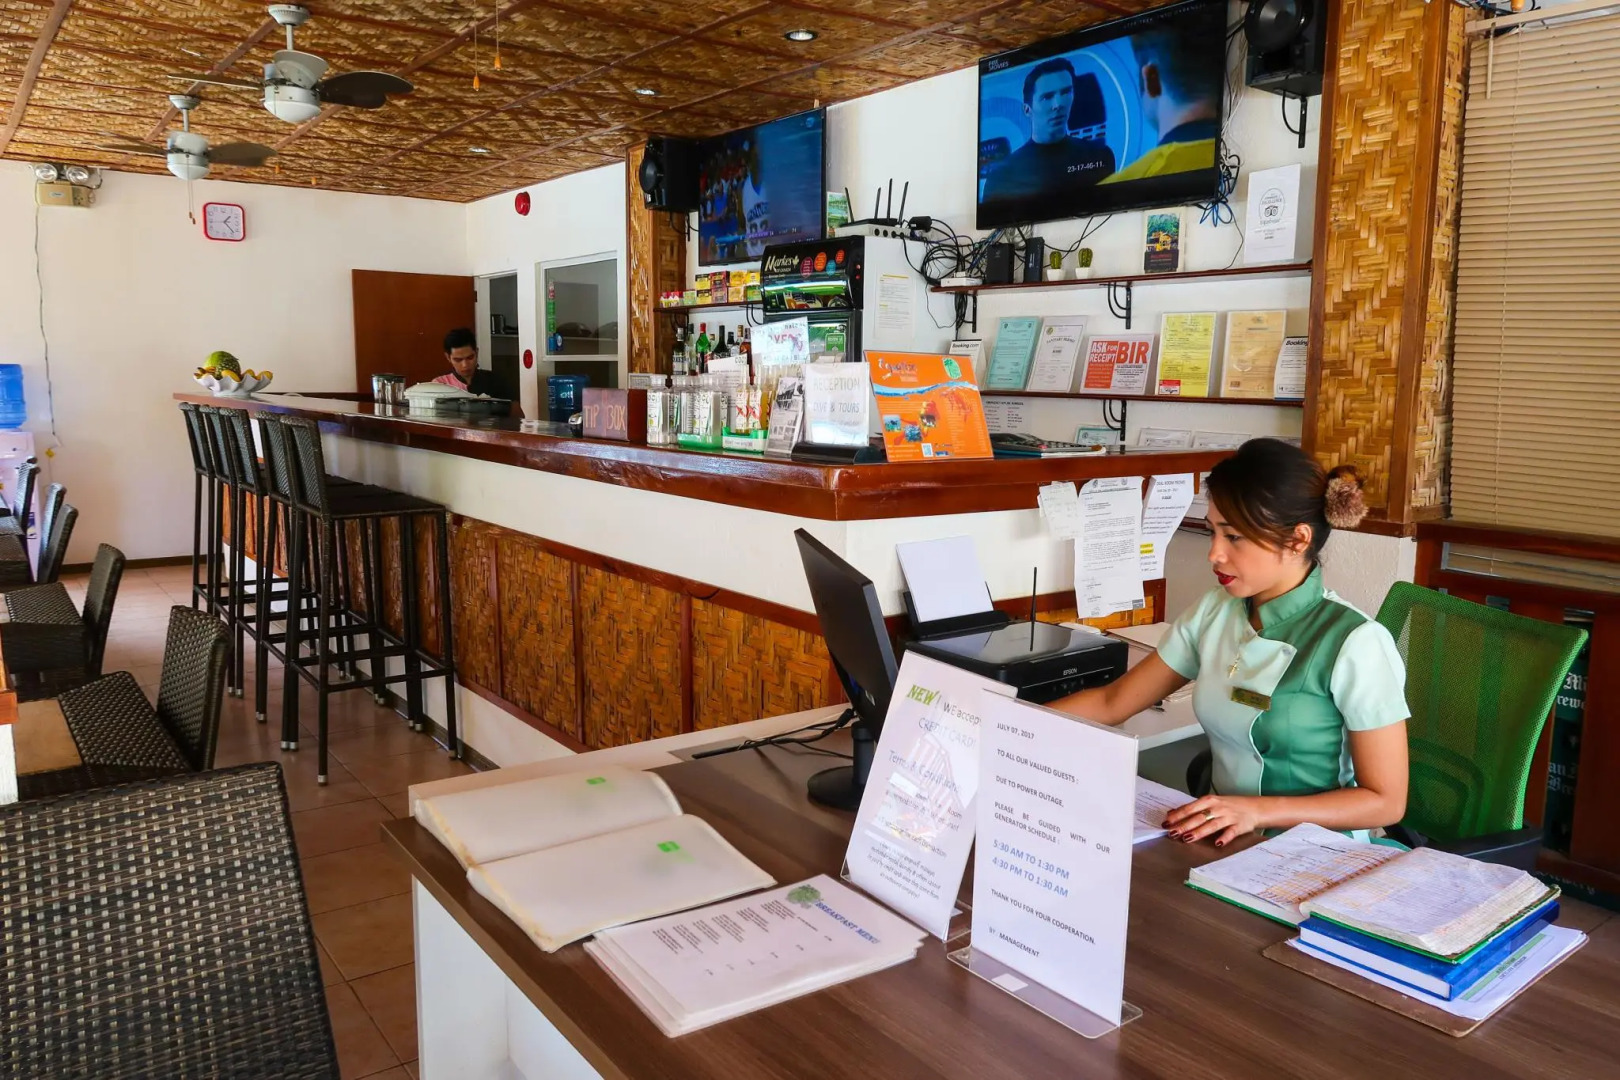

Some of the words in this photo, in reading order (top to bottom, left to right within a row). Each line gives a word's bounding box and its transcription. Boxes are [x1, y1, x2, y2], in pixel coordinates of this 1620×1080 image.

[1089, 353, 1116, 363] RECEIPT
[1091, 342, 1108, 353] ASK
[1116, 341, 1150, 364] BIR
[813, 376, 861, 391] RECEPTION
[583, 404, 600, 429] TIP
[606, 404, 626, 431] BOX
[838, 401, 860, 413] TOURS
[1062, 667, 1078, 676] EPSON
[944, 701, 958, 716] WE
[996, 722, 1010, 731] JULY
[1010, 725, 1020, 736] 07,
[1020, 728, 1035, 739] 2017
[996, 747, 1005, 757] TO
[1004, 751, 1015, 761] ALL
[1014, 754, 1028, 765] OUR
[1028, 759, 1052, 774] VALUED
[1051, 768, 1075, 783] GUESTS
[995, 774, 1007, 785] DUE
[1007, 779, 1016, 788] TO
[1015, 782, 1038, 797] POWER
[1037, 790, 1064, 807] OUTAGE,
[993, 811, 1027, 831] GENERATOR
[1027, 825, 1056, 843] SCHEDULE
[994, 800, 1013, 814] PLEASE
[1021, 811, 1029, 821] BE
[1037, 818, 1061, 833] GUIDED
[1069, 831, 1086, 844] WITH
[1095, 842, 1110, 854] OUR
[993, 838, 1009, 852] 5:30
[1009, 847, 1024, 859] AM
[1025, 852, 1036, 864] TO
[1037, 858, 1054, 872] 1:30
[1055, 866, 1069, 879] PM
[991, 856, 1009, 870] 4:30
[1008, 863, 1022, 876] PM
[1023, 869, 1035, 882] TO
[1035, 875, 1053, 890] 1:30
[1053, 884, 1068, 897] AM
[815, 901, 859, 929] BREAKFAST
[855, 928, 881, 944] MENU
[990, 887, 1009, 902] THANK
[1009, 897, 1022, 909] YOU
[1022, 903, 1034, 914] FOR
[1034, 909, 1051, 923] YOUR
[1051, 917, 1095, 945] COOPERATION.
[998, 931, 1040, 957] MANAGEMENT
